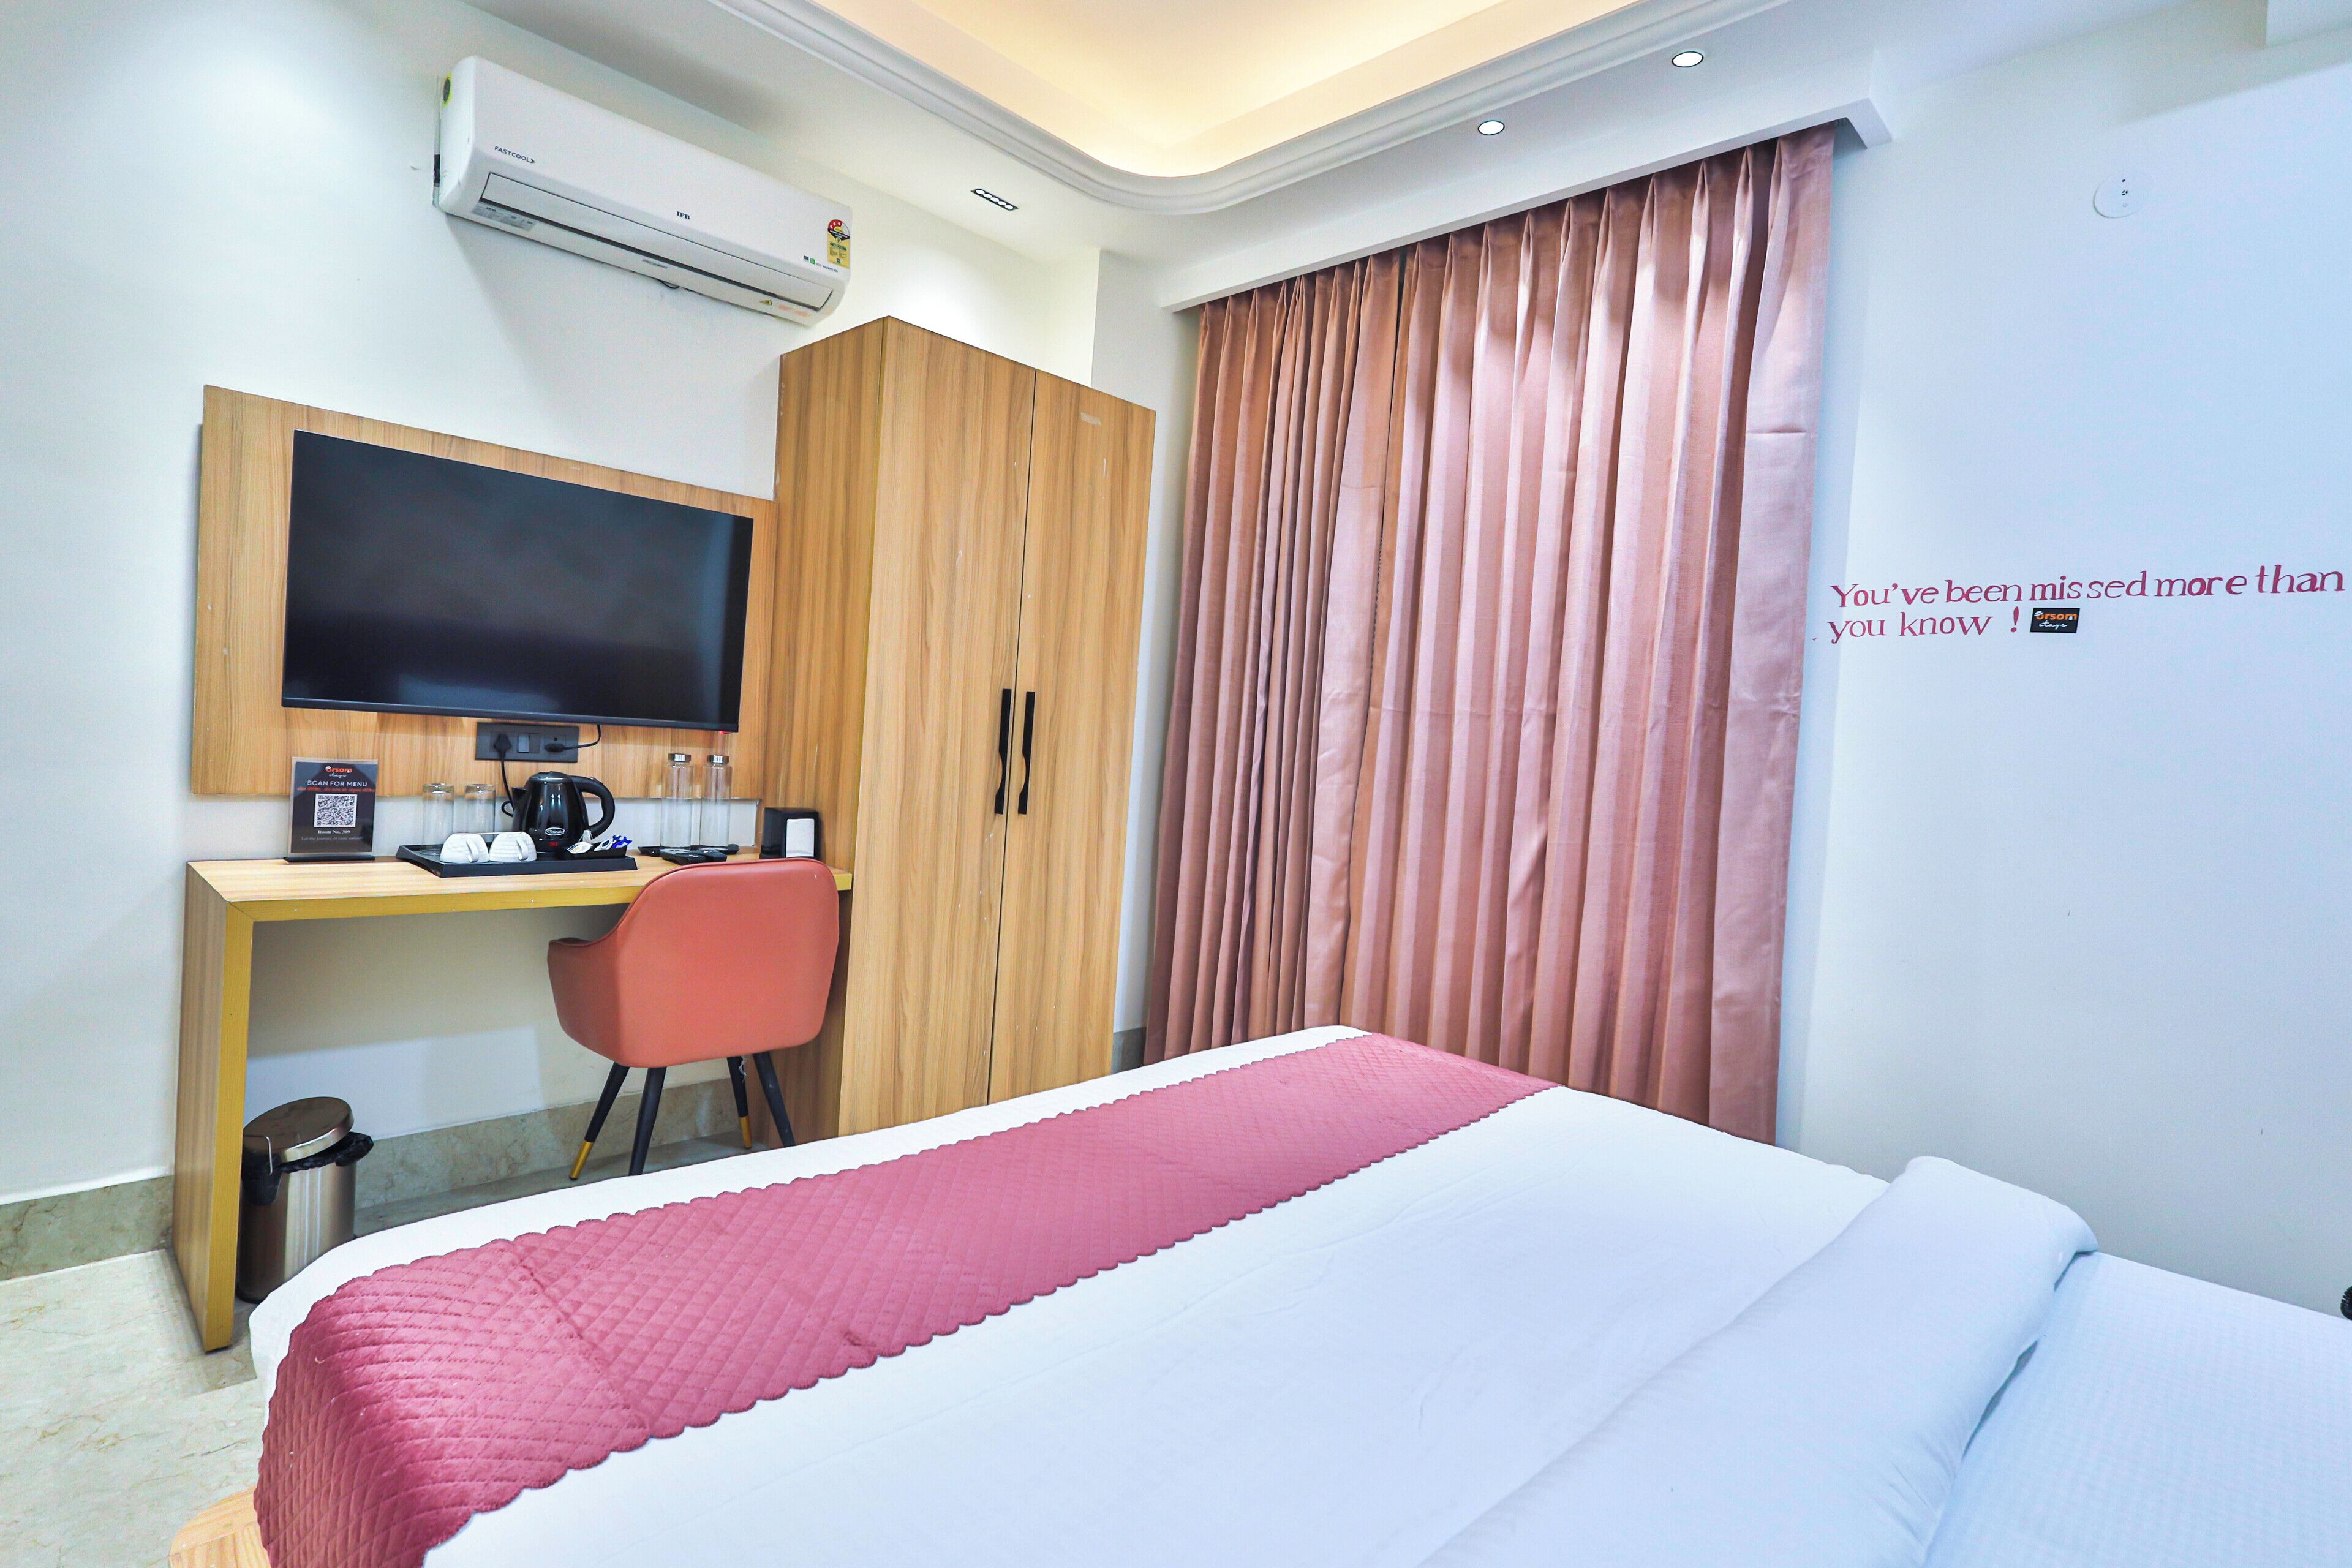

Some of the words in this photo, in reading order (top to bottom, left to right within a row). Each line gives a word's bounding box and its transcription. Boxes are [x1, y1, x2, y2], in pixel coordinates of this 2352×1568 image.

[494, 146, 535, 164] FASTCOOL
[676, 211, 690, 220] IFB
[1945, 579, 2022, 603] been
[2028, 570, 2149, 601] missed
[2154, 575, 2247, 597] more
[2255, 564, 2346, 594] than
[1827, 619, 1887, 644] you
[1899, 612, 1993, 636] know
